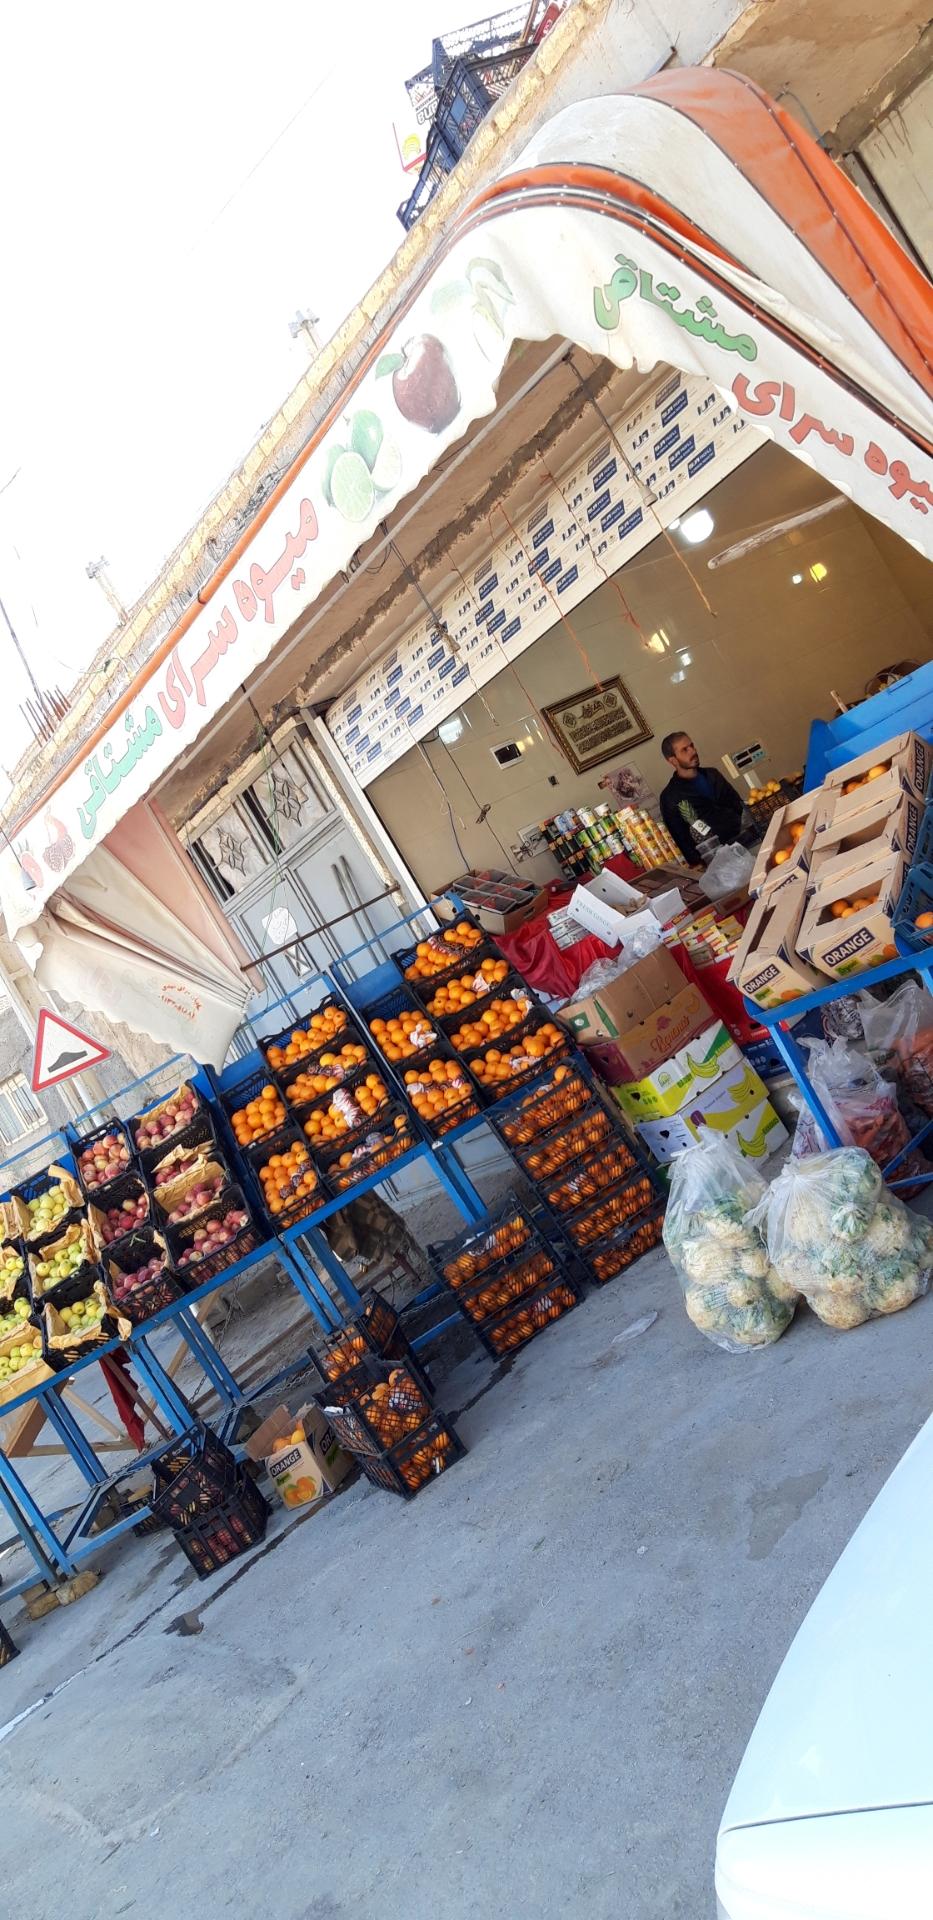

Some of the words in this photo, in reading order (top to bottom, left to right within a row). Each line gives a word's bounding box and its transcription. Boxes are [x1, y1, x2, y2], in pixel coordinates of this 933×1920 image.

[594, 254, 758, 361] مشتاق
[732, 372, 854, 457] سرای
[864, 441, 933, 515] یوه
[233, 498, 318, 624] میوه
[157, 605, 238, 730] سرای
[77, 706, 163, 839] مشتاق
[914, 741, 925, 792] ORANGE
[744, 966, 779, 995] ORANGE
[824, 929, 873, 967] ORANGE
[270, 1450, 301, 1476] ORANGE
